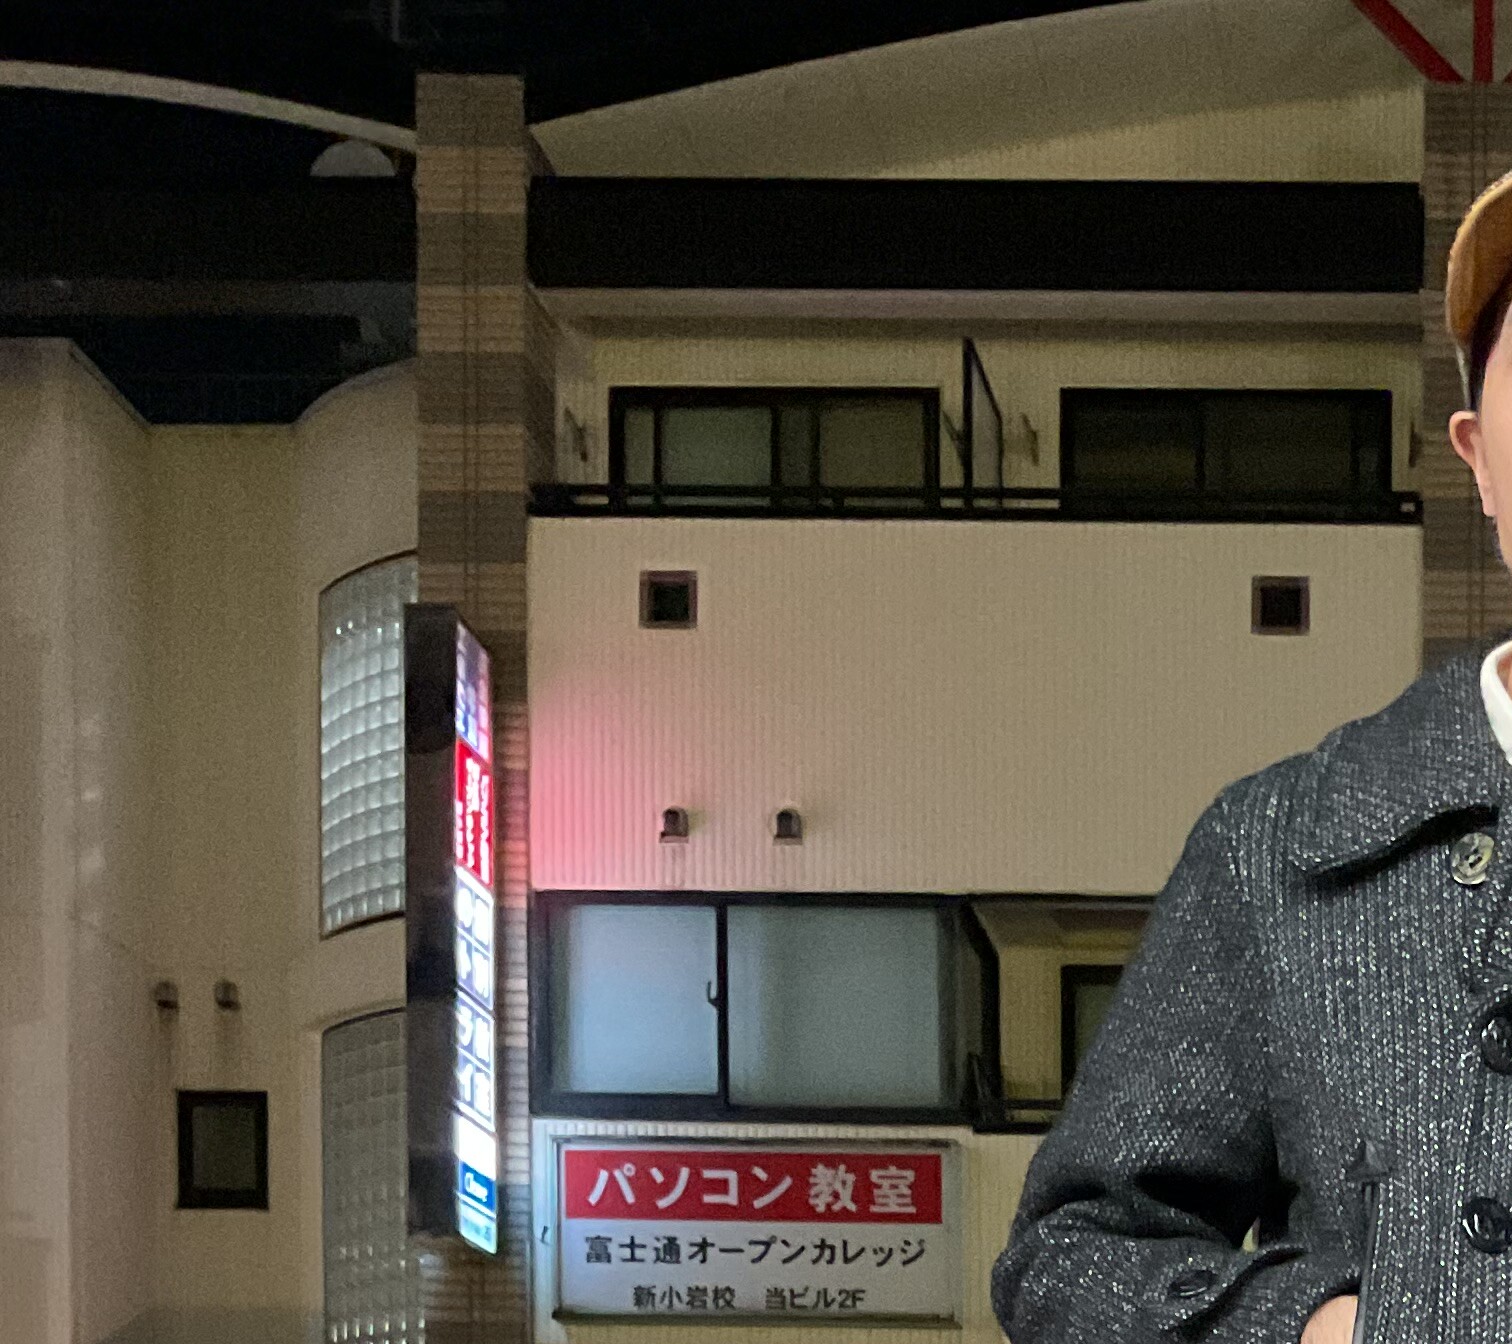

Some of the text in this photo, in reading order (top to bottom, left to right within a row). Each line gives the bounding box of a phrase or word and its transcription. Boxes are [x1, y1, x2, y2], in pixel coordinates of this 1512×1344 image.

[588, 1163, 917, 1214] パソコン教室
[585, 1235, 926, 1267] 富士通オープンカレッジ
[633, 1284, 866, 1311] 新小岩校 当ビル2F
